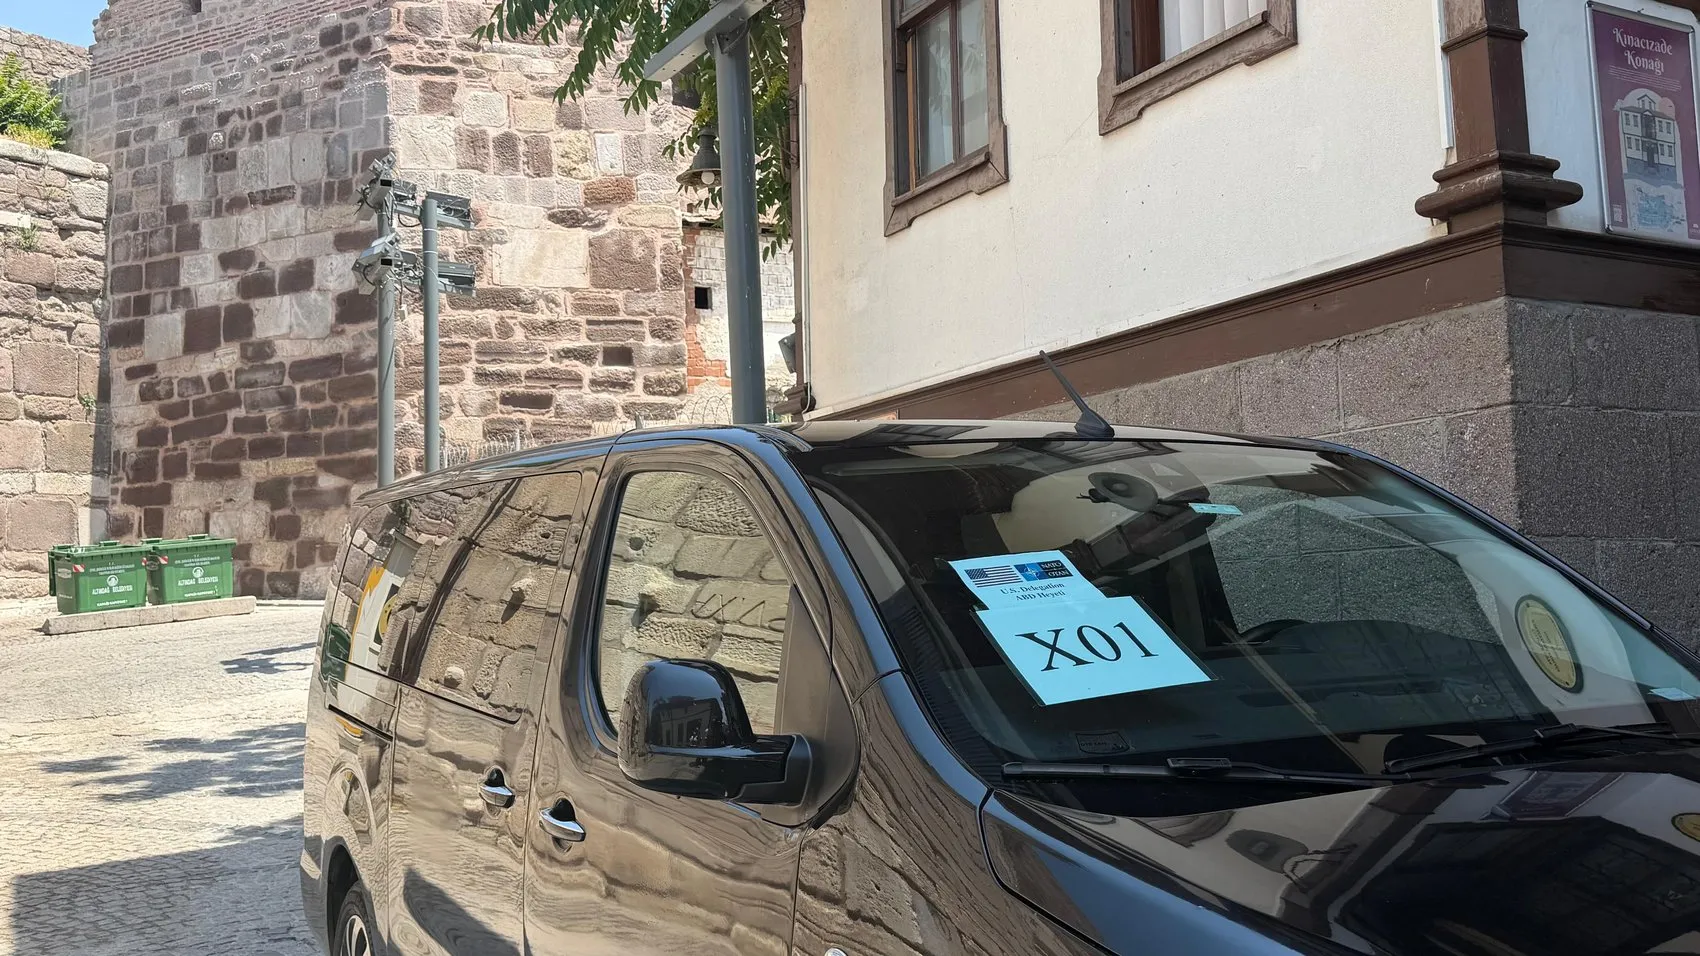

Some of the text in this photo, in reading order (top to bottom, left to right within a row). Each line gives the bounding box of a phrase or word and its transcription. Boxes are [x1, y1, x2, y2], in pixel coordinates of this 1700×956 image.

[1041, 561, 1062, 570] NATO
[1048, 569, 1070, 577] OTAN
[1000, 582, 1065, 595] U.S. Delegation
[1015, 589, 1066, 601] ABD Heyeti
[1015, 622, 1159, 672] X01
